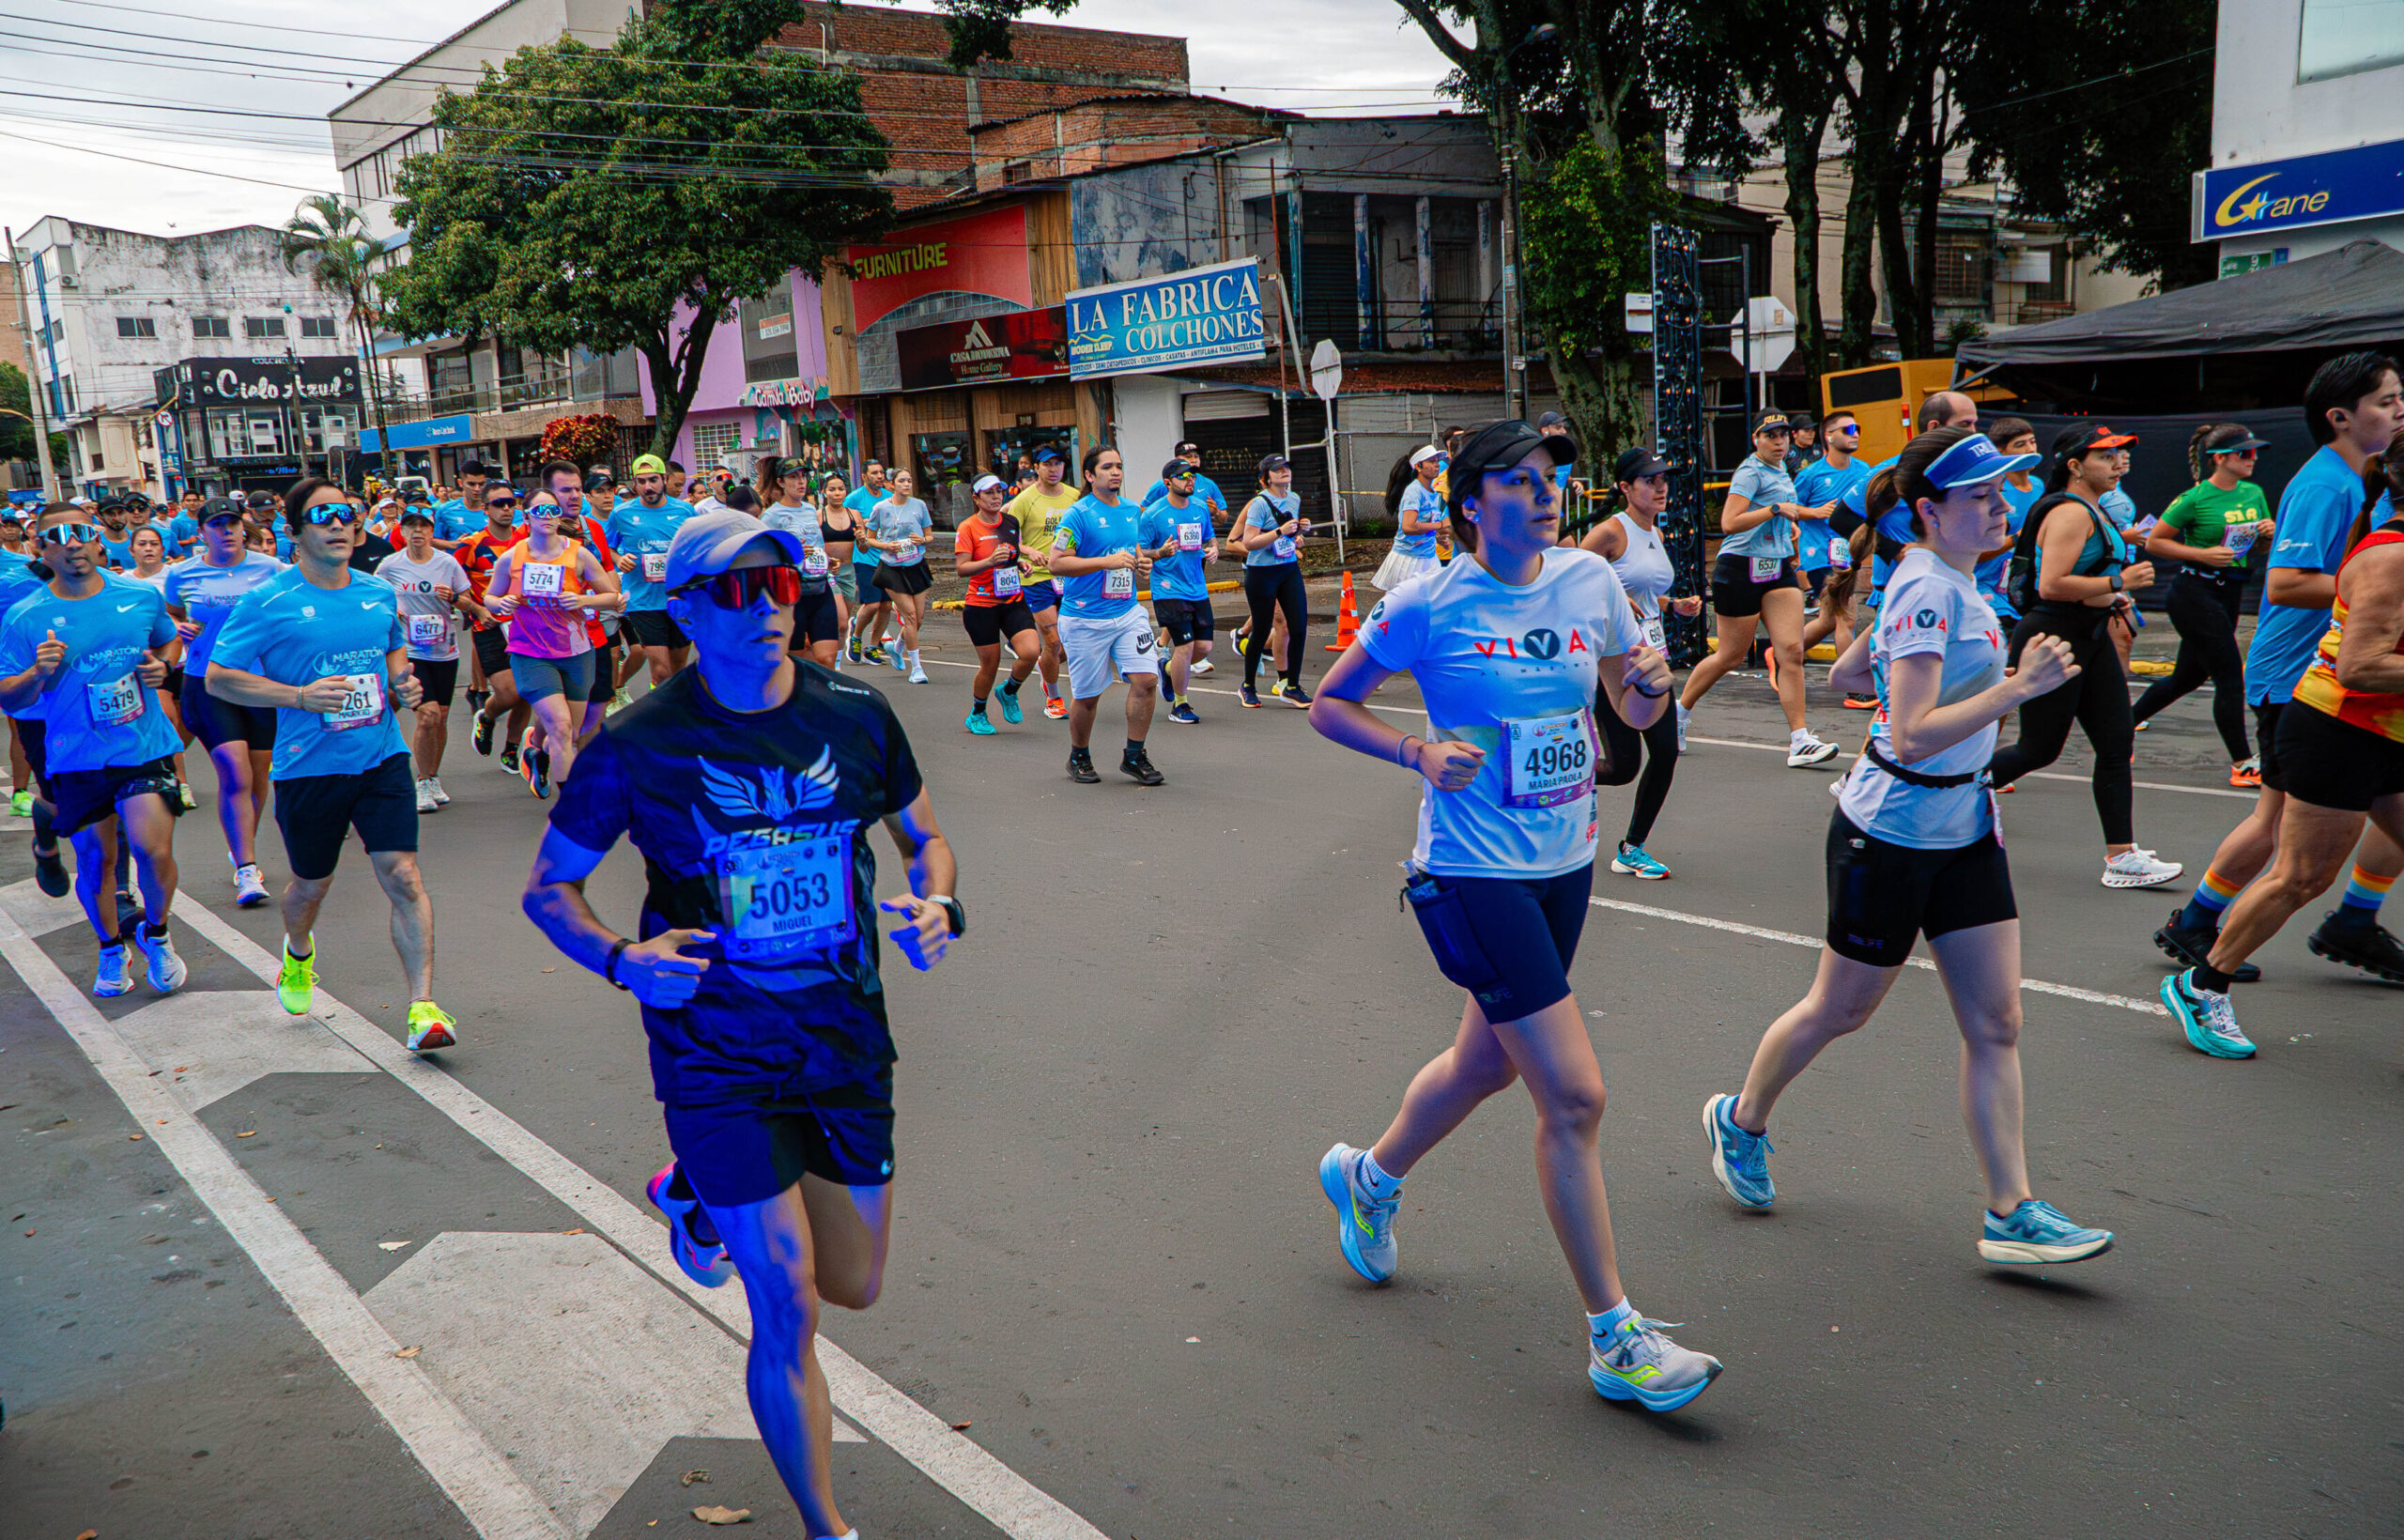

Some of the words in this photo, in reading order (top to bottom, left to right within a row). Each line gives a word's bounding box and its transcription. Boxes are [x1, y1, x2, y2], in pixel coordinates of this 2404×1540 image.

[853, 242, 948, 282] FURNITURE
[1071, 300, 1109, 334] LA
[1121, 271, 1260, 327] FABRICA
[1126, 309, 1263, 353] COLCHONES
[950, 351, 970, 363] CASA
[1141, 355, 1162, 363] CLINICOS
[1191, 347, 1219, 357] ANTIFLAMA
[1220, 345, 1232, 353] PARA
[1233, 342, 1256, 351] HOTELES
[961, 363, 979, 375] Home
[979, 362, 1003, 374] Gallery
[217, 369, 279, 399] Cielo
[755, 387, 785, 408] Camila
[789, 384, 816, 408] Baby
[529, 573, 553, 586] 5774
[1112, 577, 1131, 588] 7315
[415, 623, 439, 635] 6477
[88, 645, 141, 662] MARATÓN
[332, 646, 385, 663] MARATÓN
[1473, 628, 1587, 660] VIVA
[99, 689, 135, 712] 5479
[1525, 739, 1586, 778] 4968
[1529, 780, 1558, 790] MARIA
[1558, 772, 1583, 785] PAOLA
[702, 819, 861, 859] PEGASUS
[749, 872, 830, 919] 5053
[772, 915, 813, 932] MIGUEL
